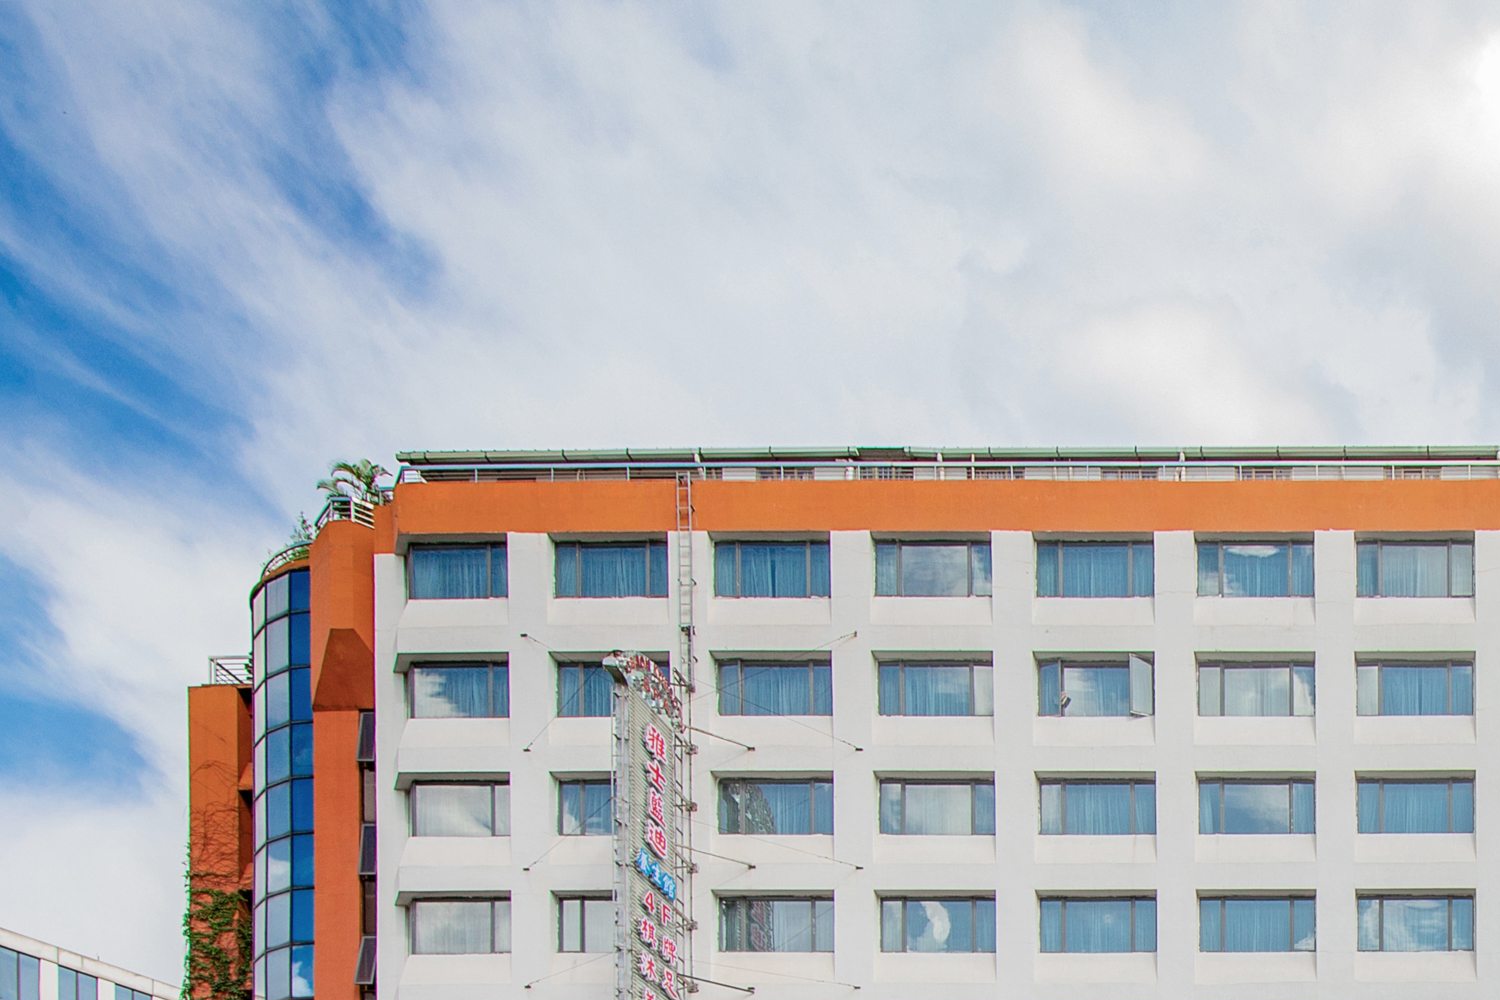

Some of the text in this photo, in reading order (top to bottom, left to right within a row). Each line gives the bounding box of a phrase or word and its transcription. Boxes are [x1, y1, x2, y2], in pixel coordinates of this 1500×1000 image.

[642, 890, 673, 926] 4F
[640, 918, 678, 966] 棋牌
[640, 951, 679, 1000] 沐足
